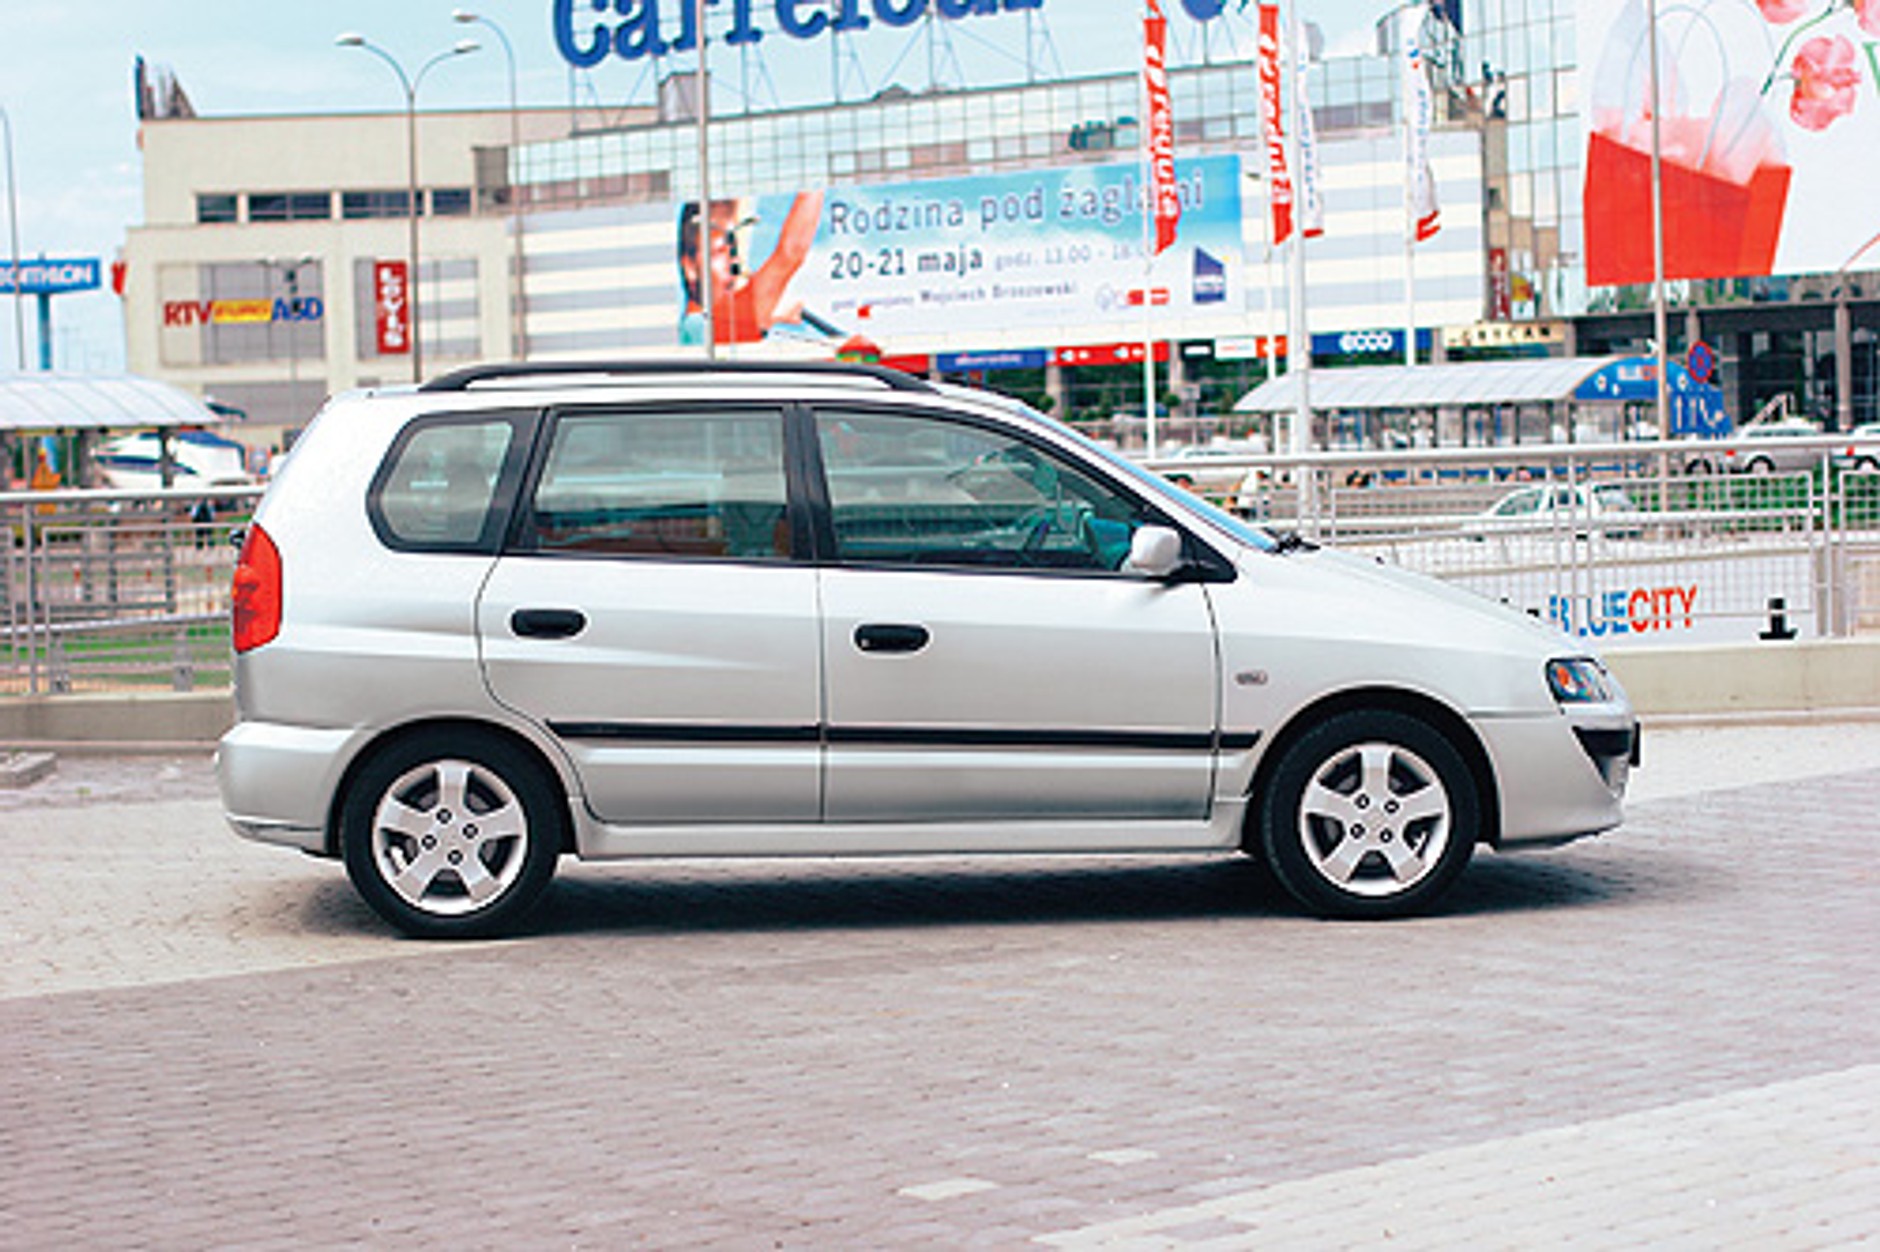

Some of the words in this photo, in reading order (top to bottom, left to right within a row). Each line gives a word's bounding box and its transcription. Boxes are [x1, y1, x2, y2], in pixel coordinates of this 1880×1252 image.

[830, 196, 963, 234] Rodzina
[981, 184, 1042, 231] pod
[831, 248, 904, 279] 20-21
[918, 244, 983, 277] maja
[164, 300, 213, 326] RTV
